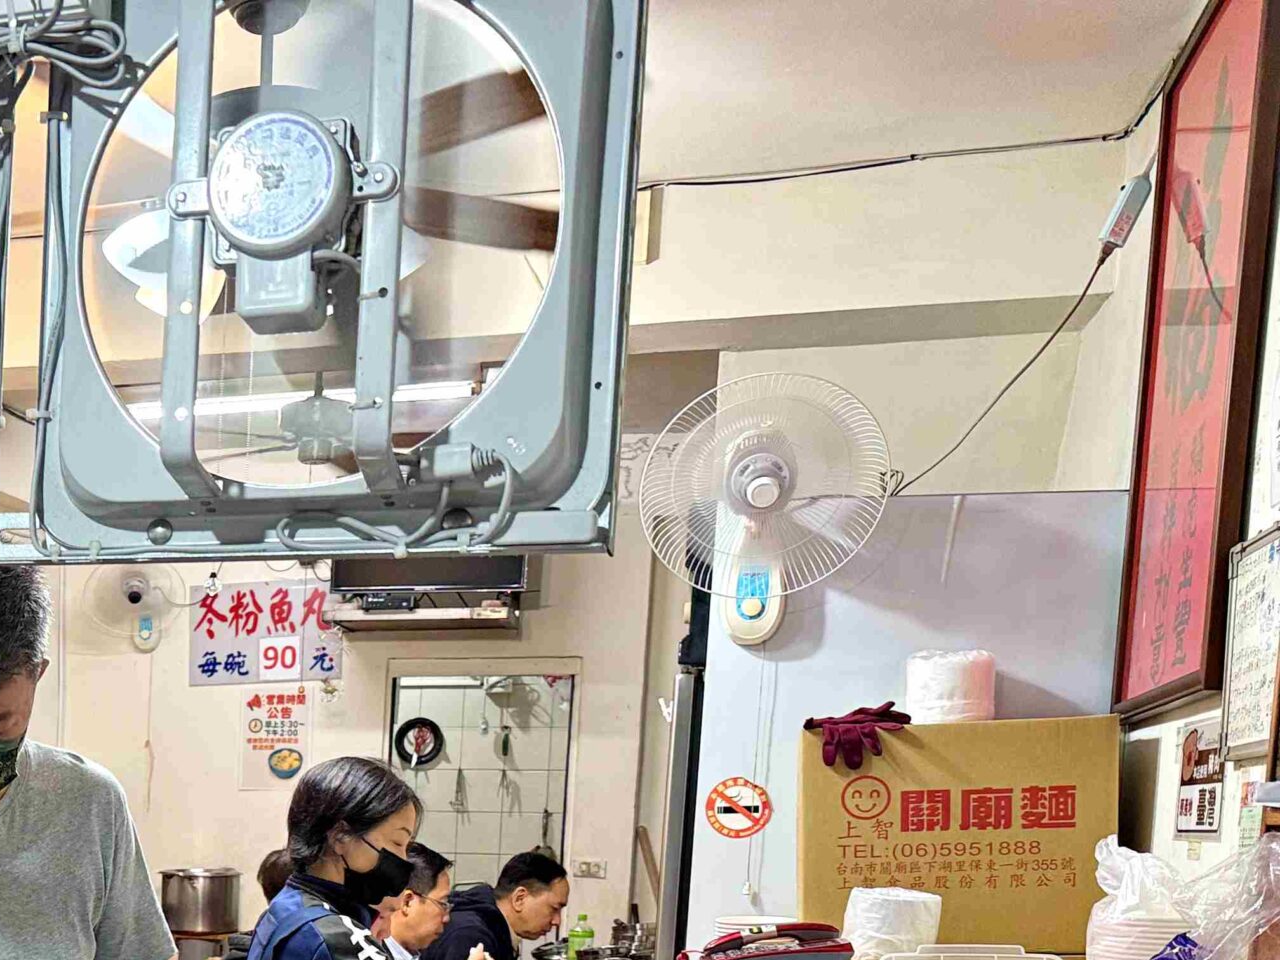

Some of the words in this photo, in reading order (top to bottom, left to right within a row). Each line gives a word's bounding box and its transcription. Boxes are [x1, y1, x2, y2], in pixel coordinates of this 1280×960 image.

[193, 588, 332, 639] 冬粉魚丸
[198, 651, 249, 677] 每碗
[263, 646, 296, 670] 90
[309, 647, 334, 672] 元
[266, 707, 292, 719] 公告
[900, 785, 1077, 832] 關廟麵
[837, 818, 894, 841] 上智
[837, 840, 1042, 860] TEL:(06)5951888
